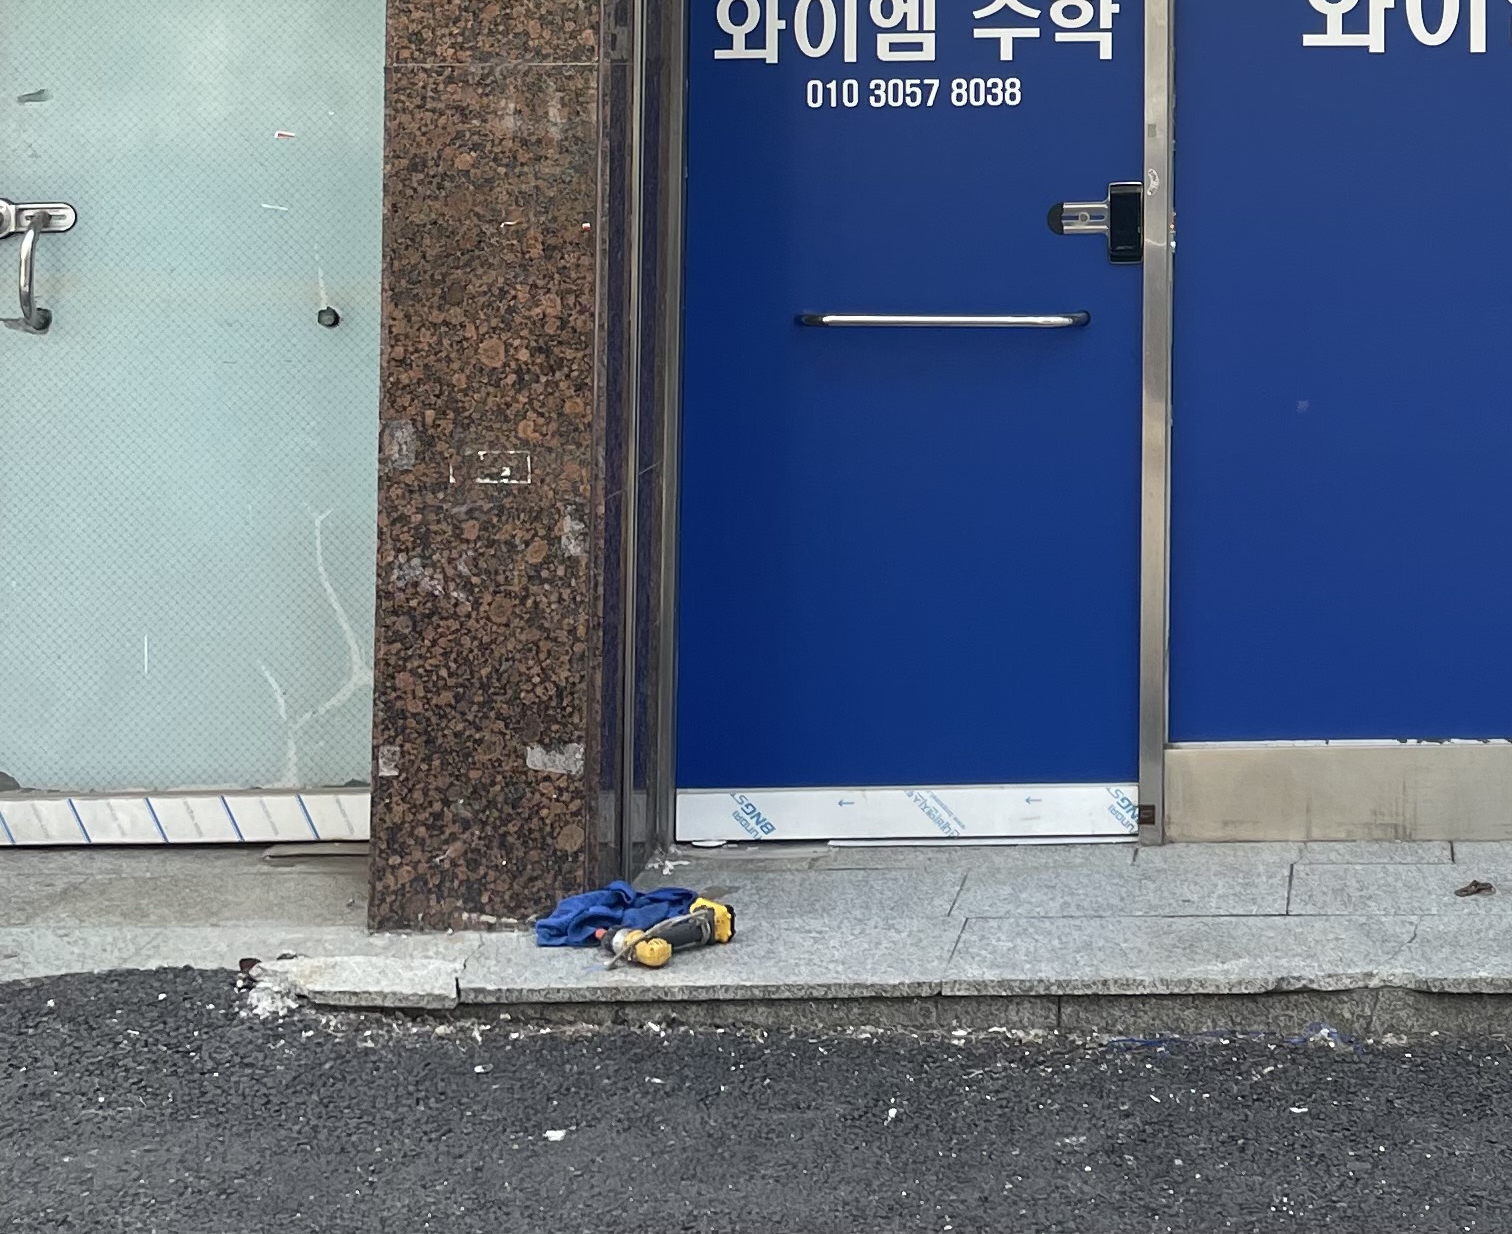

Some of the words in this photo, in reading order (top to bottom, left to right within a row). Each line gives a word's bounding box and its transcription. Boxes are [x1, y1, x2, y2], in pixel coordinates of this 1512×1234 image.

[806, 78, 859, 108] 010
[869, 78, 940, 108] 3057
[950, 77, 1022, 107] 8038
